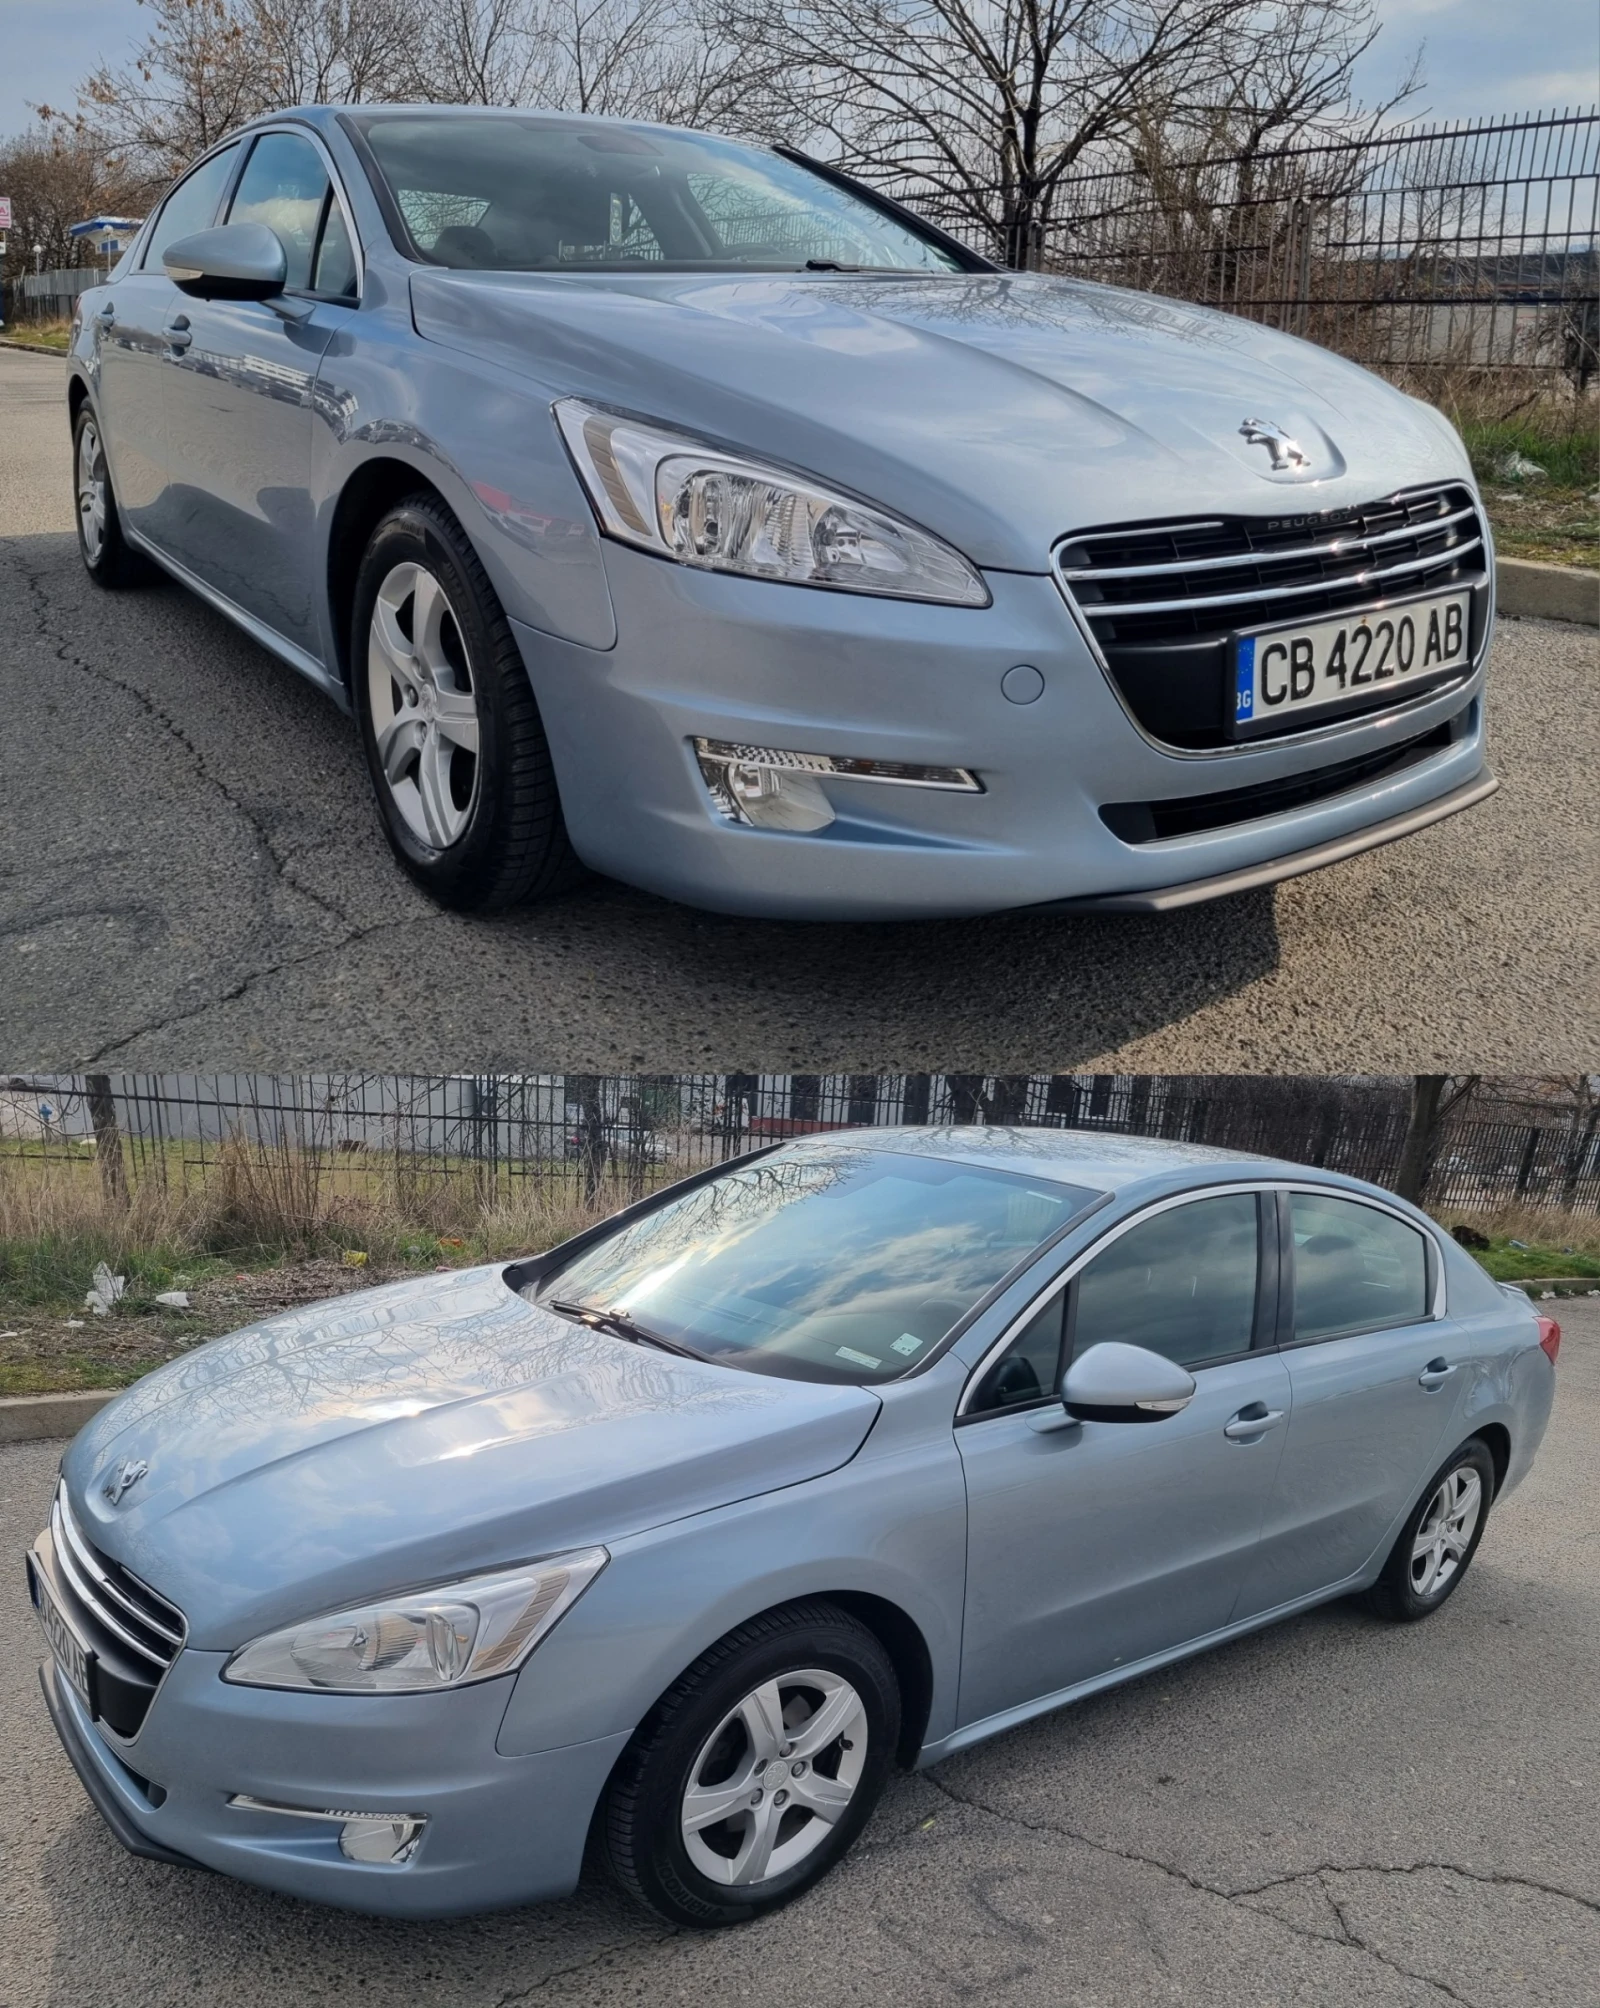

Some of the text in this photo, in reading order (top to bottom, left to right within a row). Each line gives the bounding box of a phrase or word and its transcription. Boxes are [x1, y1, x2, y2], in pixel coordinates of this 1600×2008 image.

[1267, 510, 1351, 530] PEUGEOT
[1260, 603, 1463, 706] CB 4220 AB
